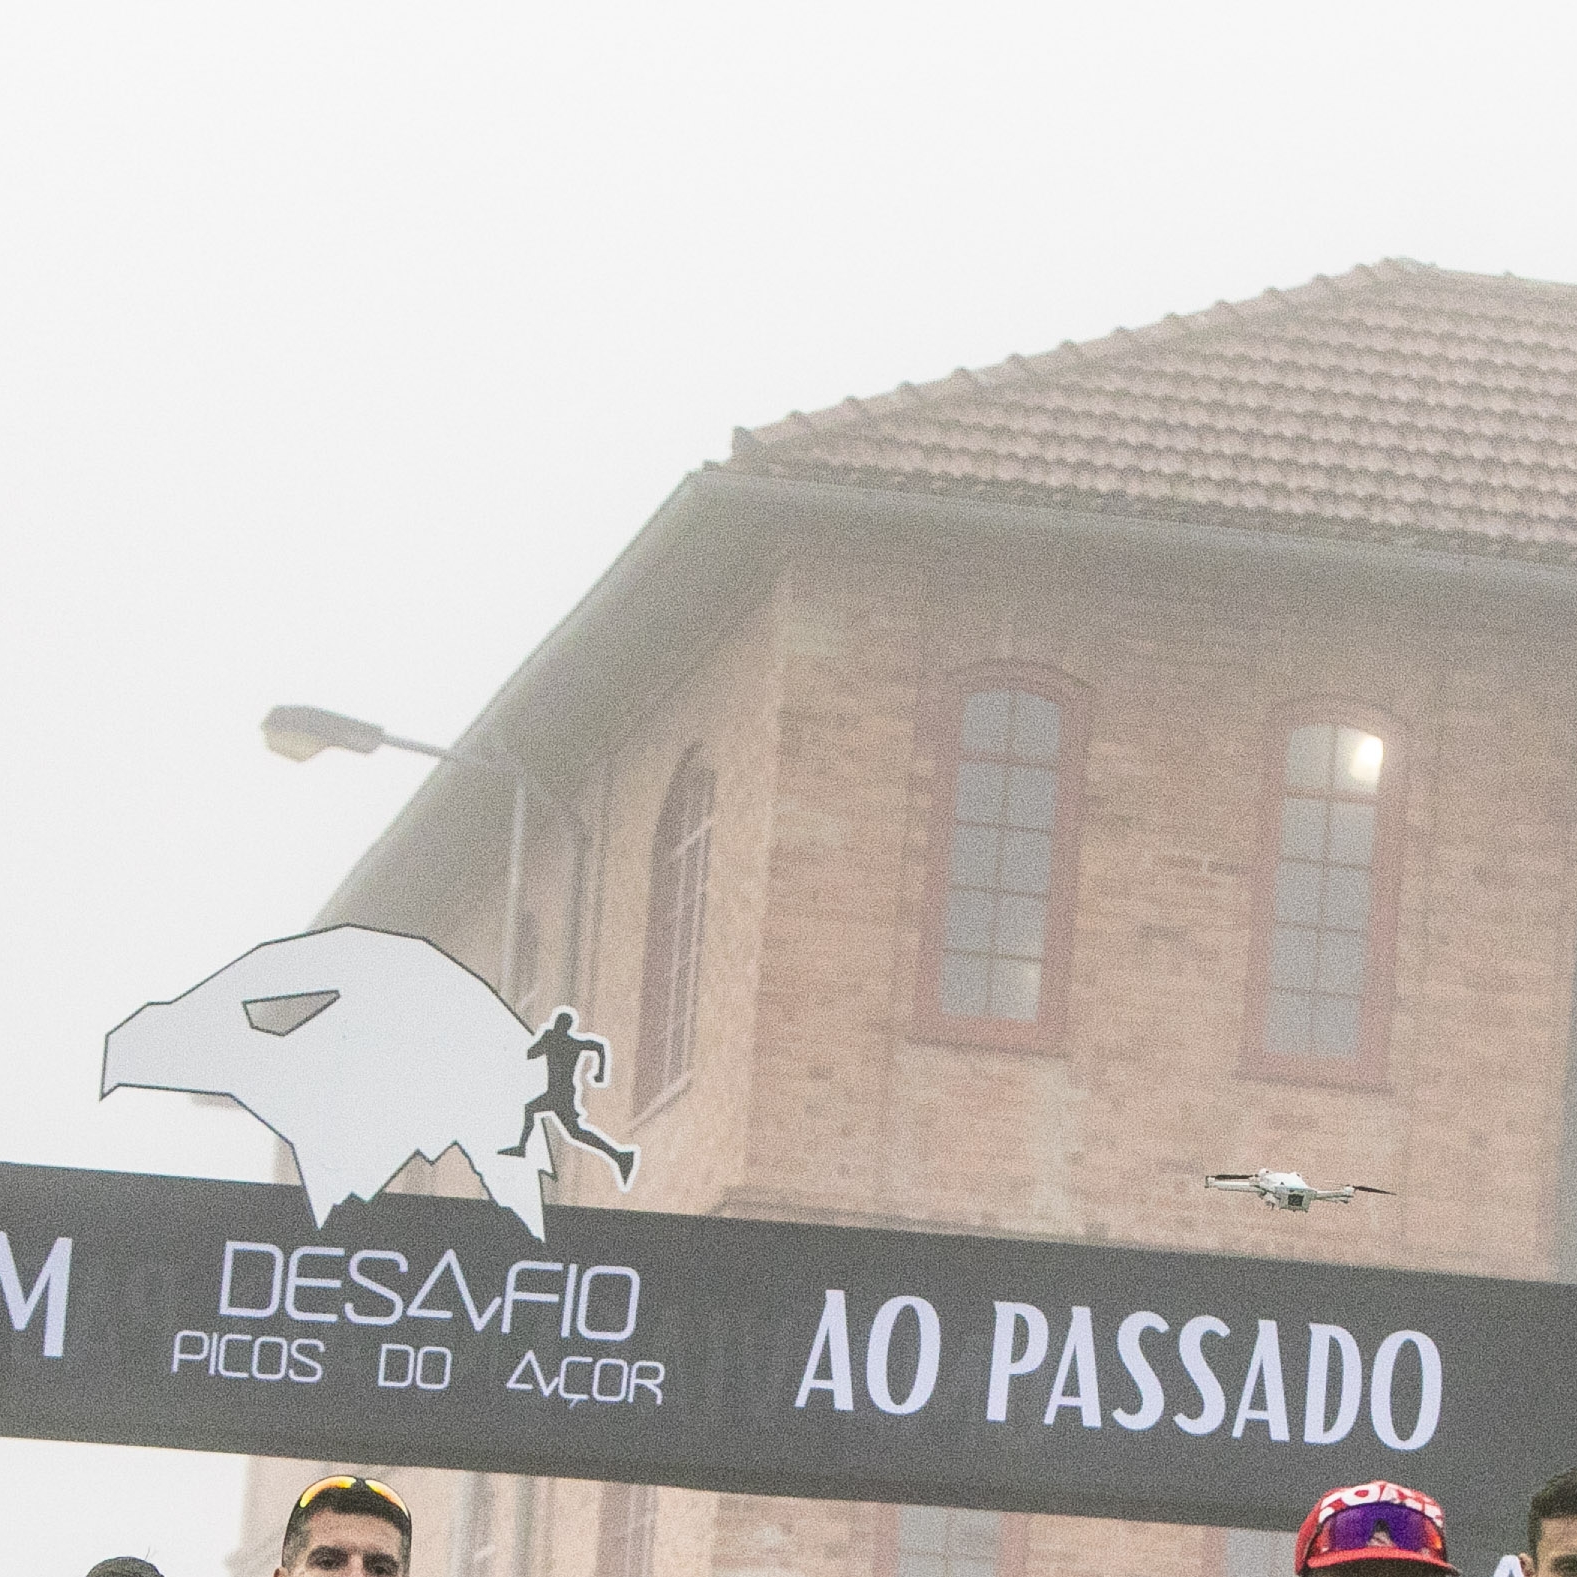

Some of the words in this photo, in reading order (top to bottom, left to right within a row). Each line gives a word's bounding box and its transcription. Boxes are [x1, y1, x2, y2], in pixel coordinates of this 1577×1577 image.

[216, 1237, 642, 1347] DESAFIO
[168, 1328, 328, 1386] PICOS
[374, 1340, 456, 1393] DO
[503, 1347, 669, 1409] AÇOR
[793, 1287, 942, 1417] AO
[985, 1300, 1445, 1452] PASSADO
